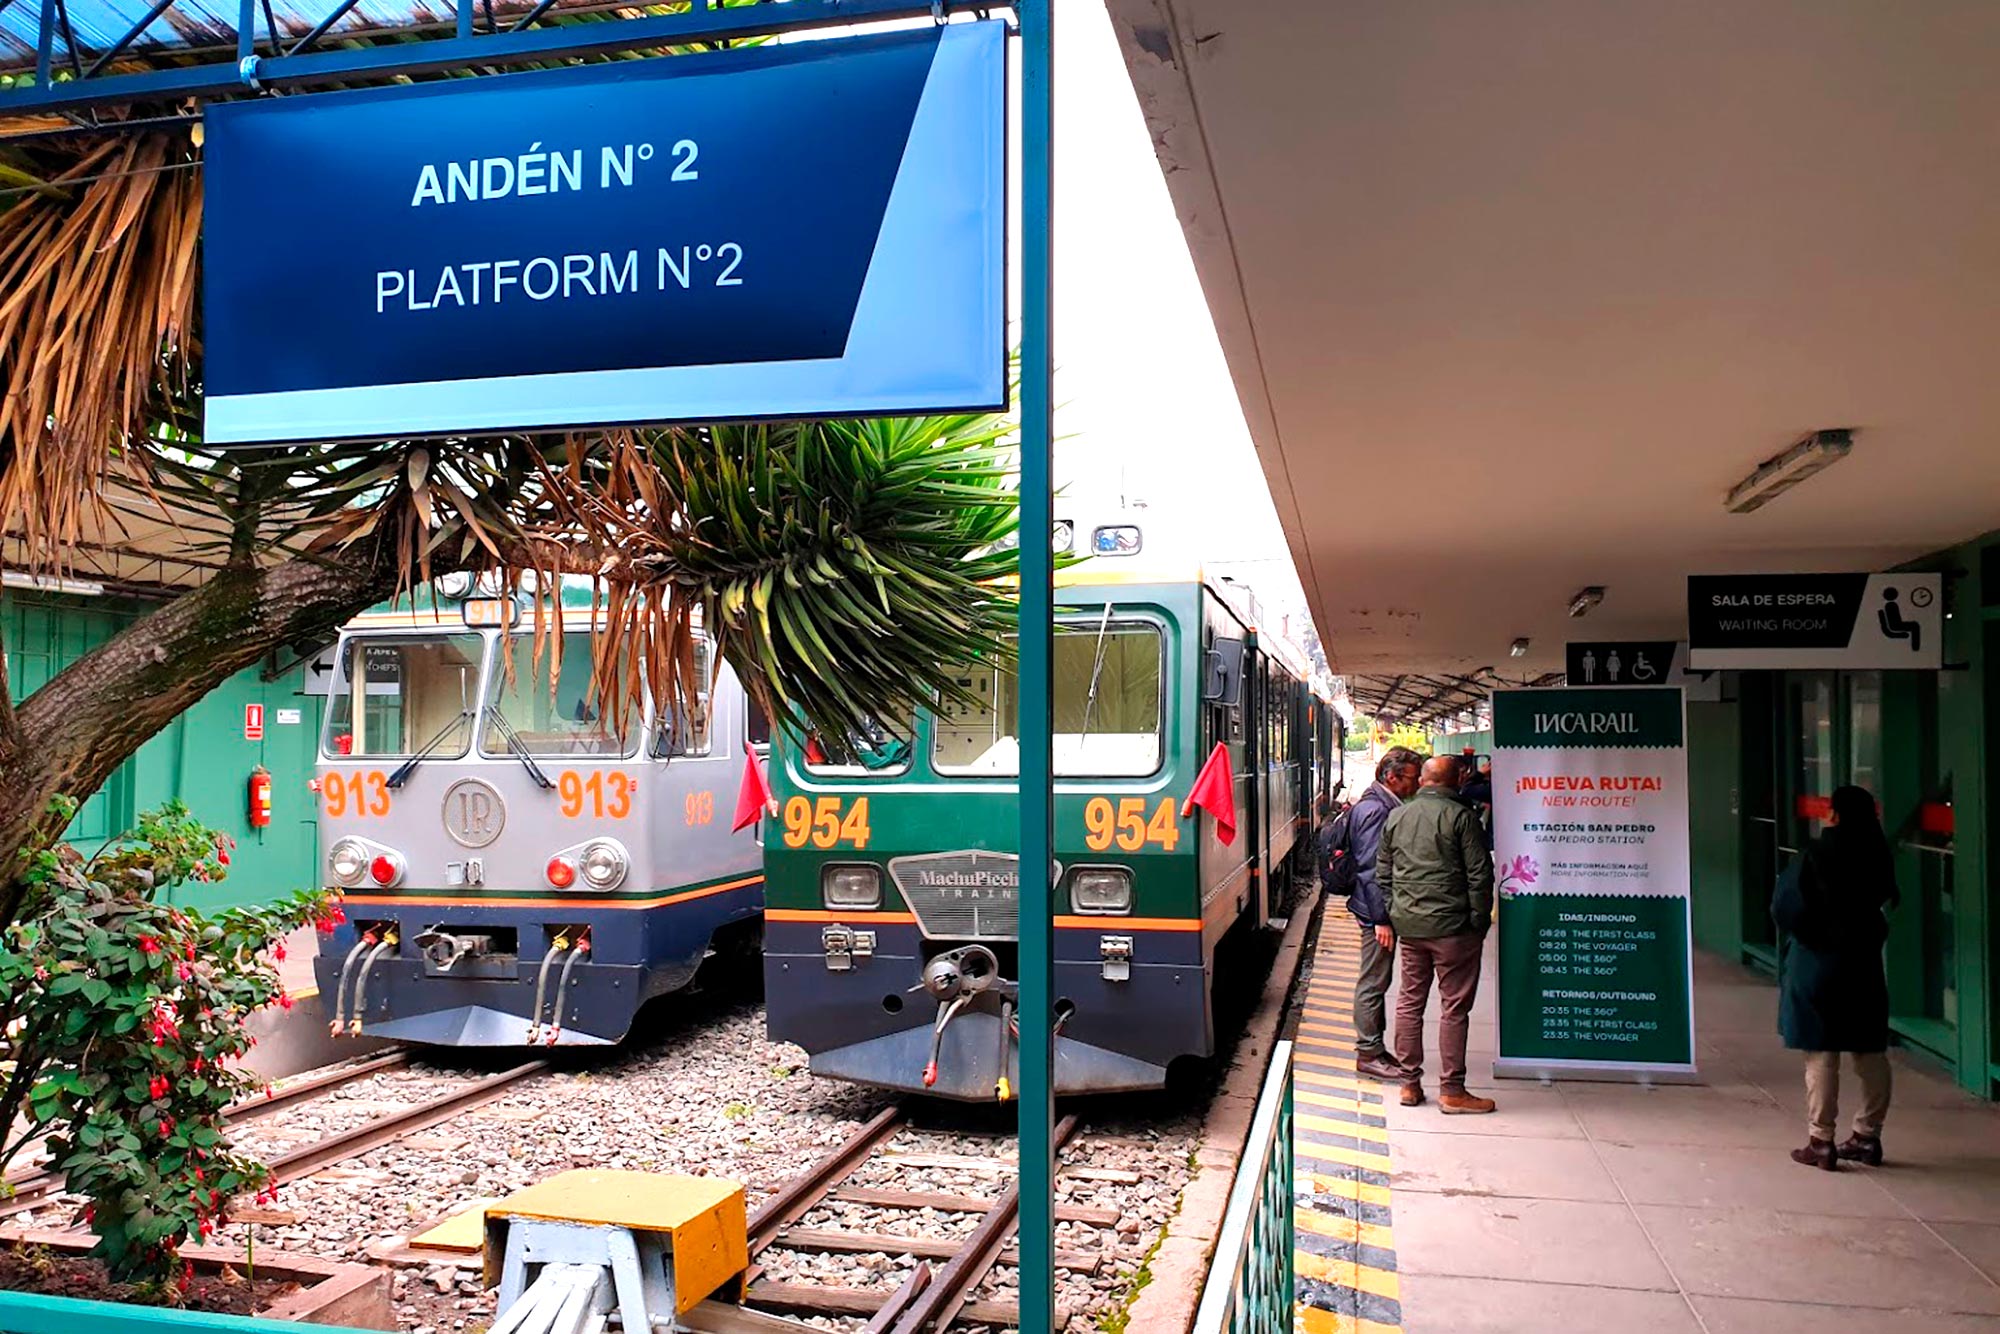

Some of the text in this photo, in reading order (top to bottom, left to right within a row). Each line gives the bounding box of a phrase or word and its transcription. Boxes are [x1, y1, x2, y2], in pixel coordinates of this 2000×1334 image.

[411, 139, 699, 207] ANDÉN N° 2
[376, 243, 743, 313] PLATFORM N°2
[1712, 594, 1835, 606] SALA DE ESPERA
[470, 601, 511, 624] 91
[1719, 619, 1827, 631] WAITING ROOM
[1516, 776, 1662, 794] ¡NUEVA RUTA!
[323, 770, 390, 818] 913
[558, 769, 632, 819] 913
[1542, 796, 1636, 807] NEW ROUTE!
[685, 790, 714, 827] 913
[782, 796, 871, 849] 954
[1084, 797, 1179, 851] 954
[1523, 822, 1656, 833] ESTACIÓN SAN PEDRO
[1534, 835, 1645, 844] SAN PEDRO STATION
[919, 870, 1020, 888] MachuPicch
[1574, 870, 1628, 878] INFORMATION
[1558, 913, 1637, 923] IDAS/INBOUND
[1573, 930, 1590, 938] THE
[1592, 930, 1622, 938] FIRST
[1624, 931, 1656, 940] CLASS
[1573, 942, 1591, 950] THE
[1592, 942, 1637, 951] VOYAGER
[1573, 954, 1591, 962] THE
[1573, 967, 1591, 975] THE
[1542, 990, 1656, 1001] RETORNOS/OUTBOUND
[1573, 1007, 1591, 1015] THE
[1574, 1019, 1592, 1028] THE
[1594, 1020, 1623, 1029] FIRST
[1625, 1021, 1657, 1030] CLASS
[1574, 1032, 1593, 1040] THE
[1594, 1032, 1639, 1042] VOYAGER
